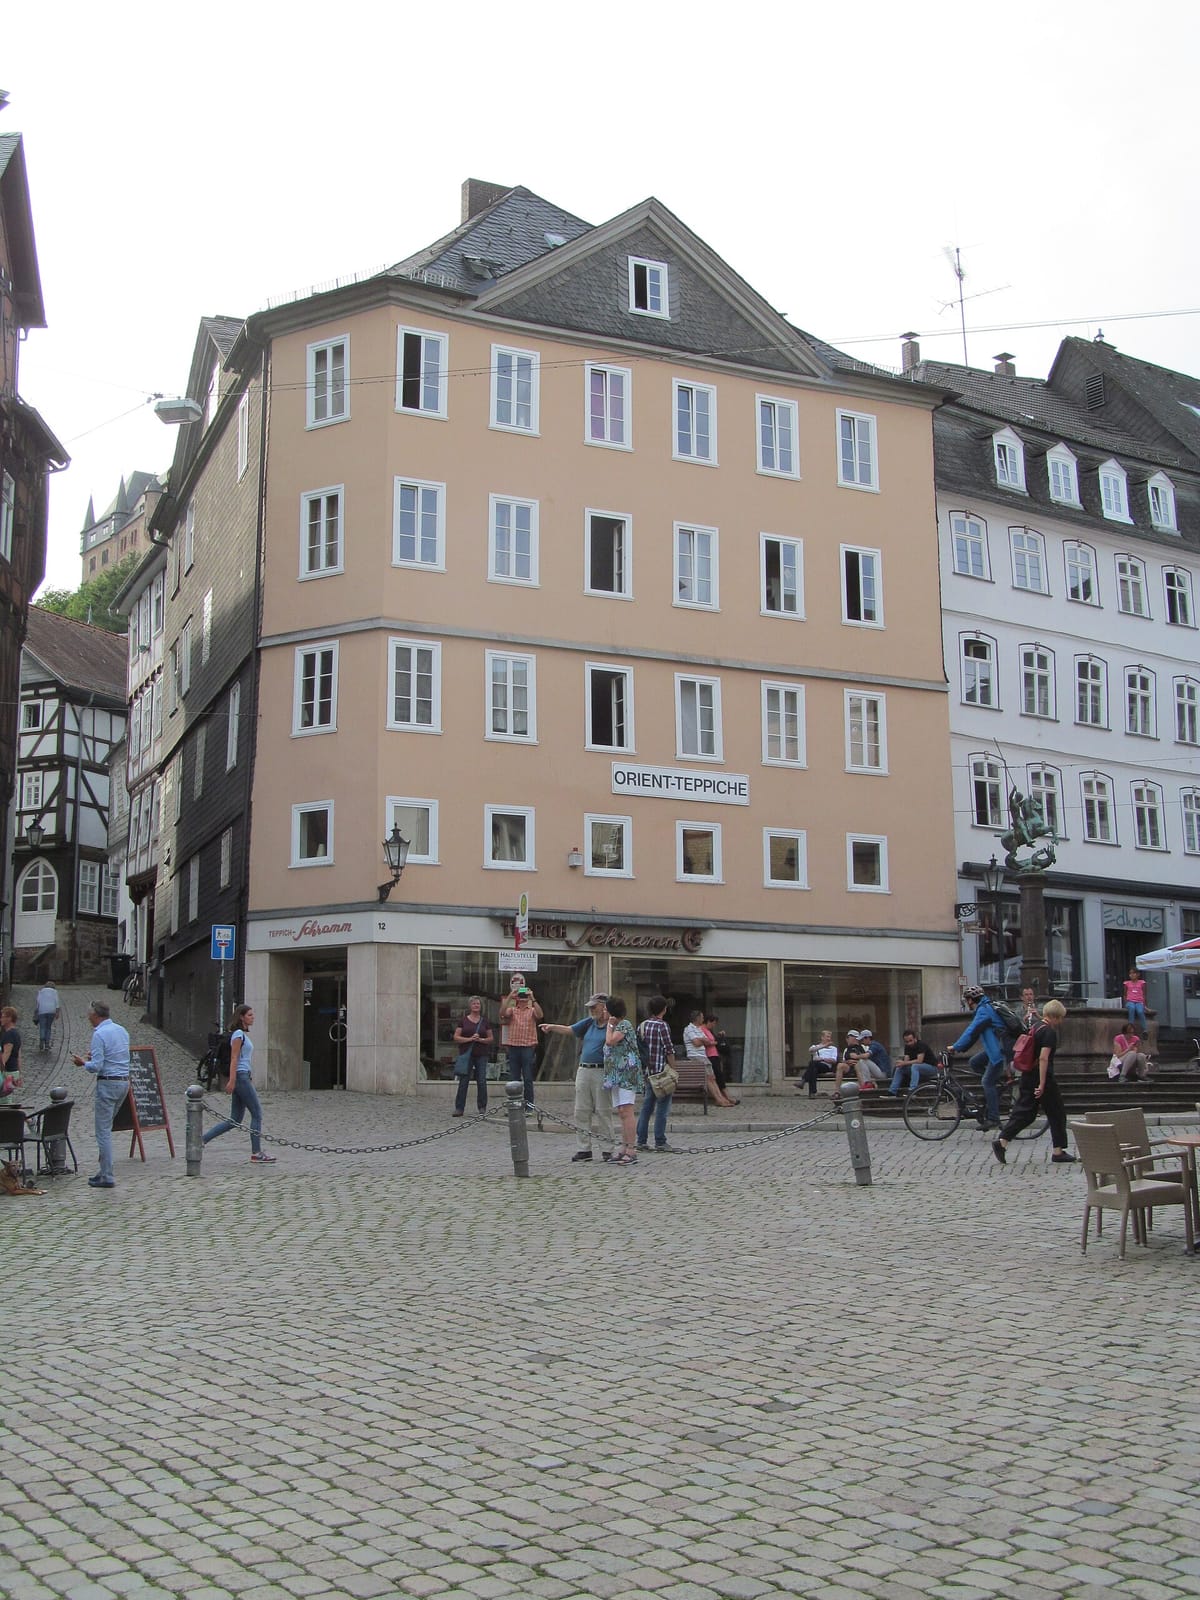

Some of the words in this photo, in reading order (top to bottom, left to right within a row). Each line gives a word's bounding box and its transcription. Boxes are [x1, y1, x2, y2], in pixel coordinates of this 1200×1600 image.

[614, 771, 747, 796] ORIENT-TEPPICHE
[378, 922, 386, 930] 12
[1103, 908, 1161, 930] Edlunds
[565, 925, 682, 950] Schramm
